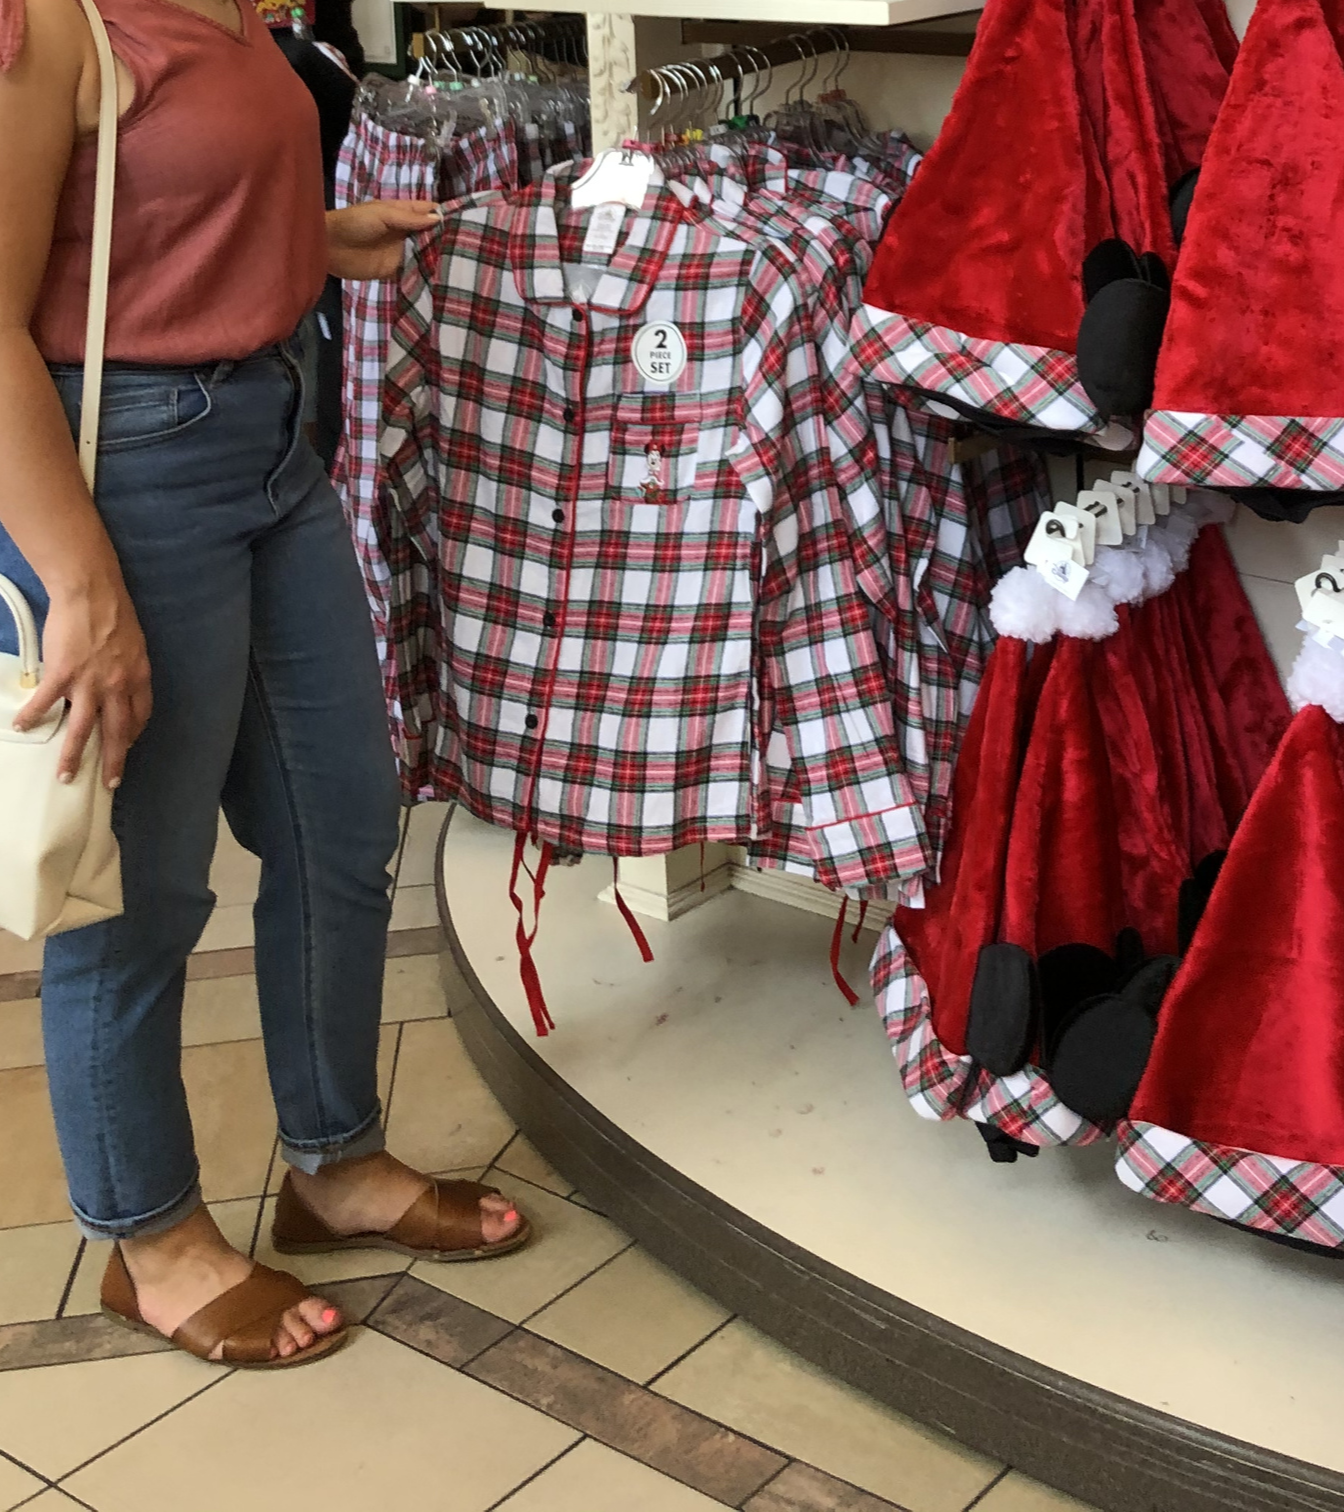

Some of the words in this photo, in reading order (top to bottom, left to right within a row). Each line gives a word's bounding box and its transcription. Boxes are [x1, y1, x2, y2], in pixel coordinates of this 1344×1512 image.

[654, 329, 668, 349] 2
[649, 350, 672, 360] PIECE
[650, 361, 672, 374] SET
